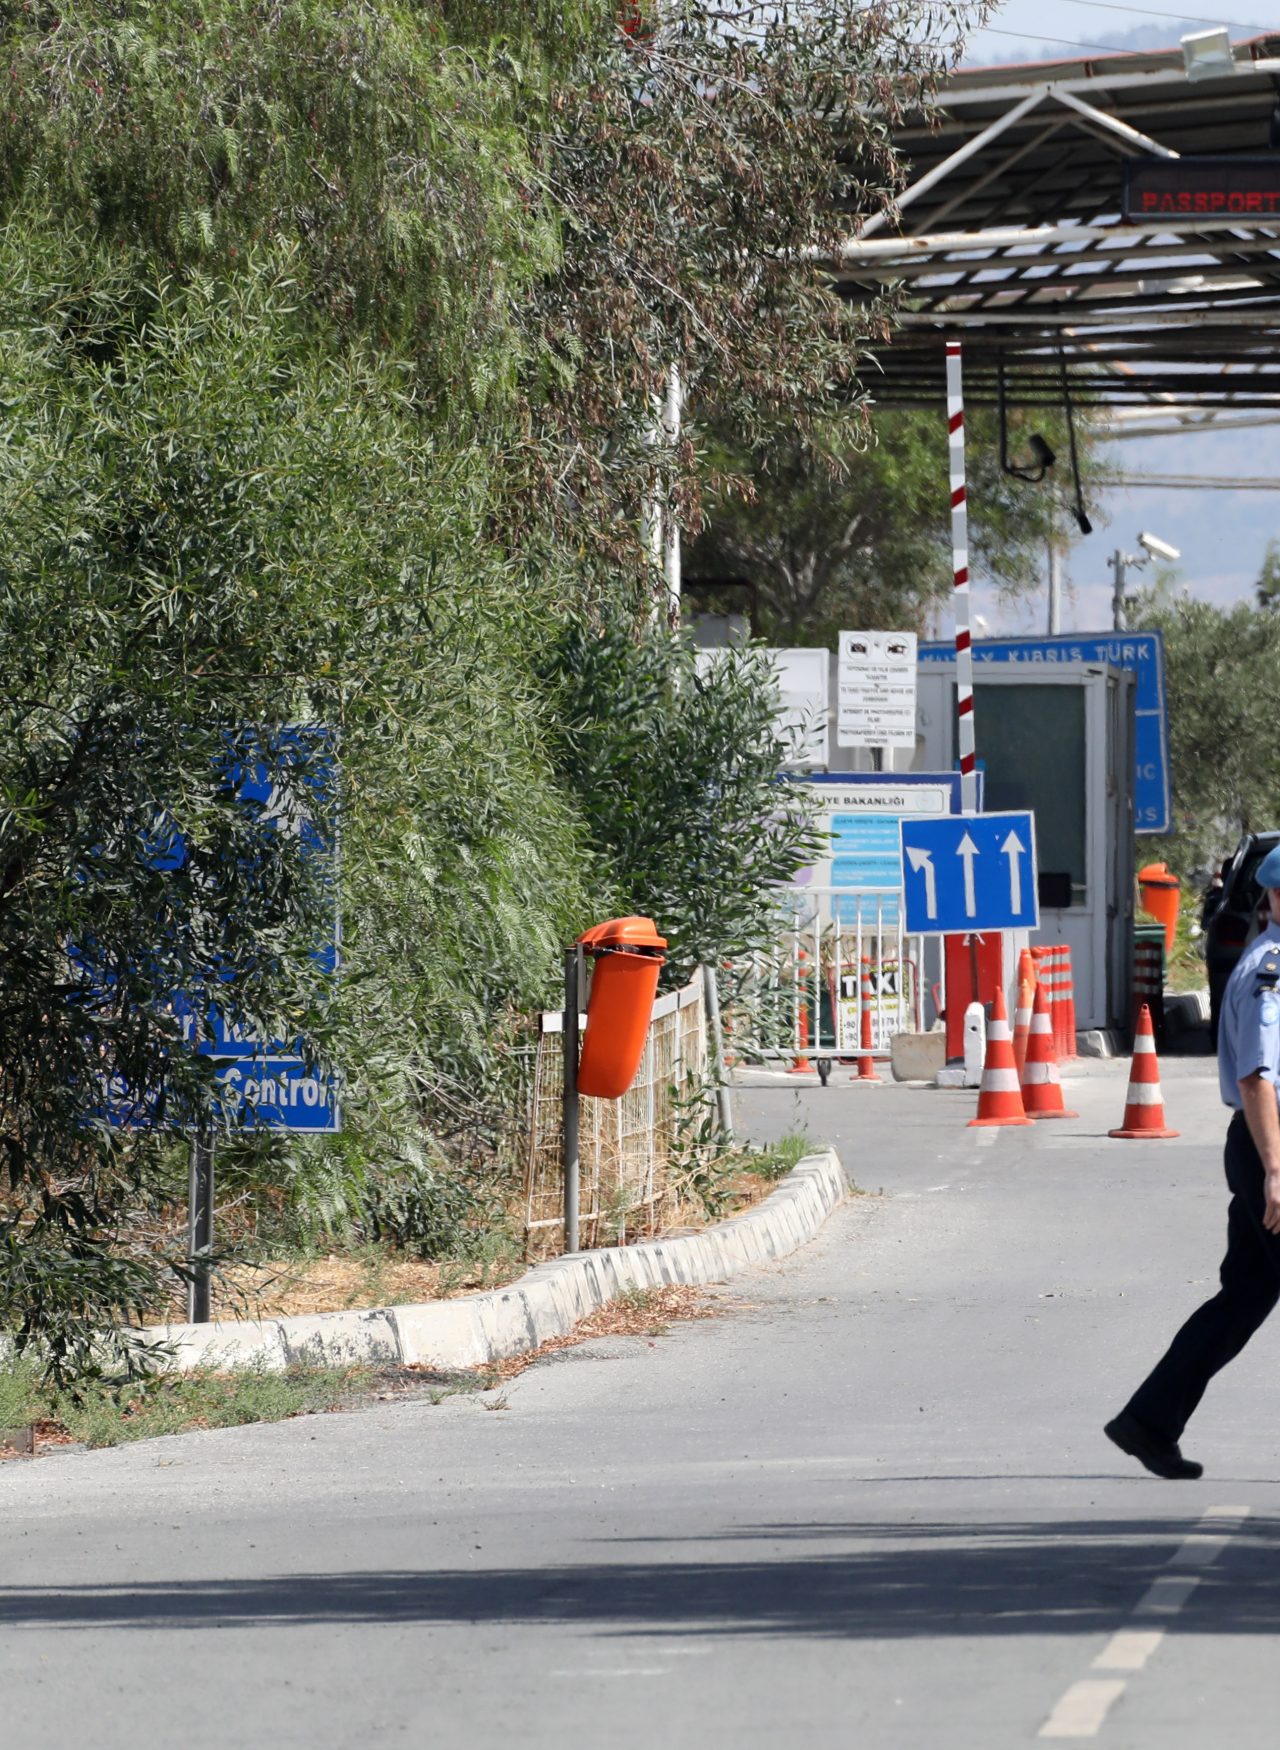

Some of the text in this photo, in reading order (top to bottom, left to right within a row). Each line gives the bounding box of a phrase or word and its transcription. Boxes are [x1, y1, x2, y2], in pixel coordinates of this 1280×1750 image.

[1142, 192, 1280, 212] PASSPORT
[1094, 642, 1149, 661] TÜRK
[844, 796, 904, 806] BAKANLIĞI
